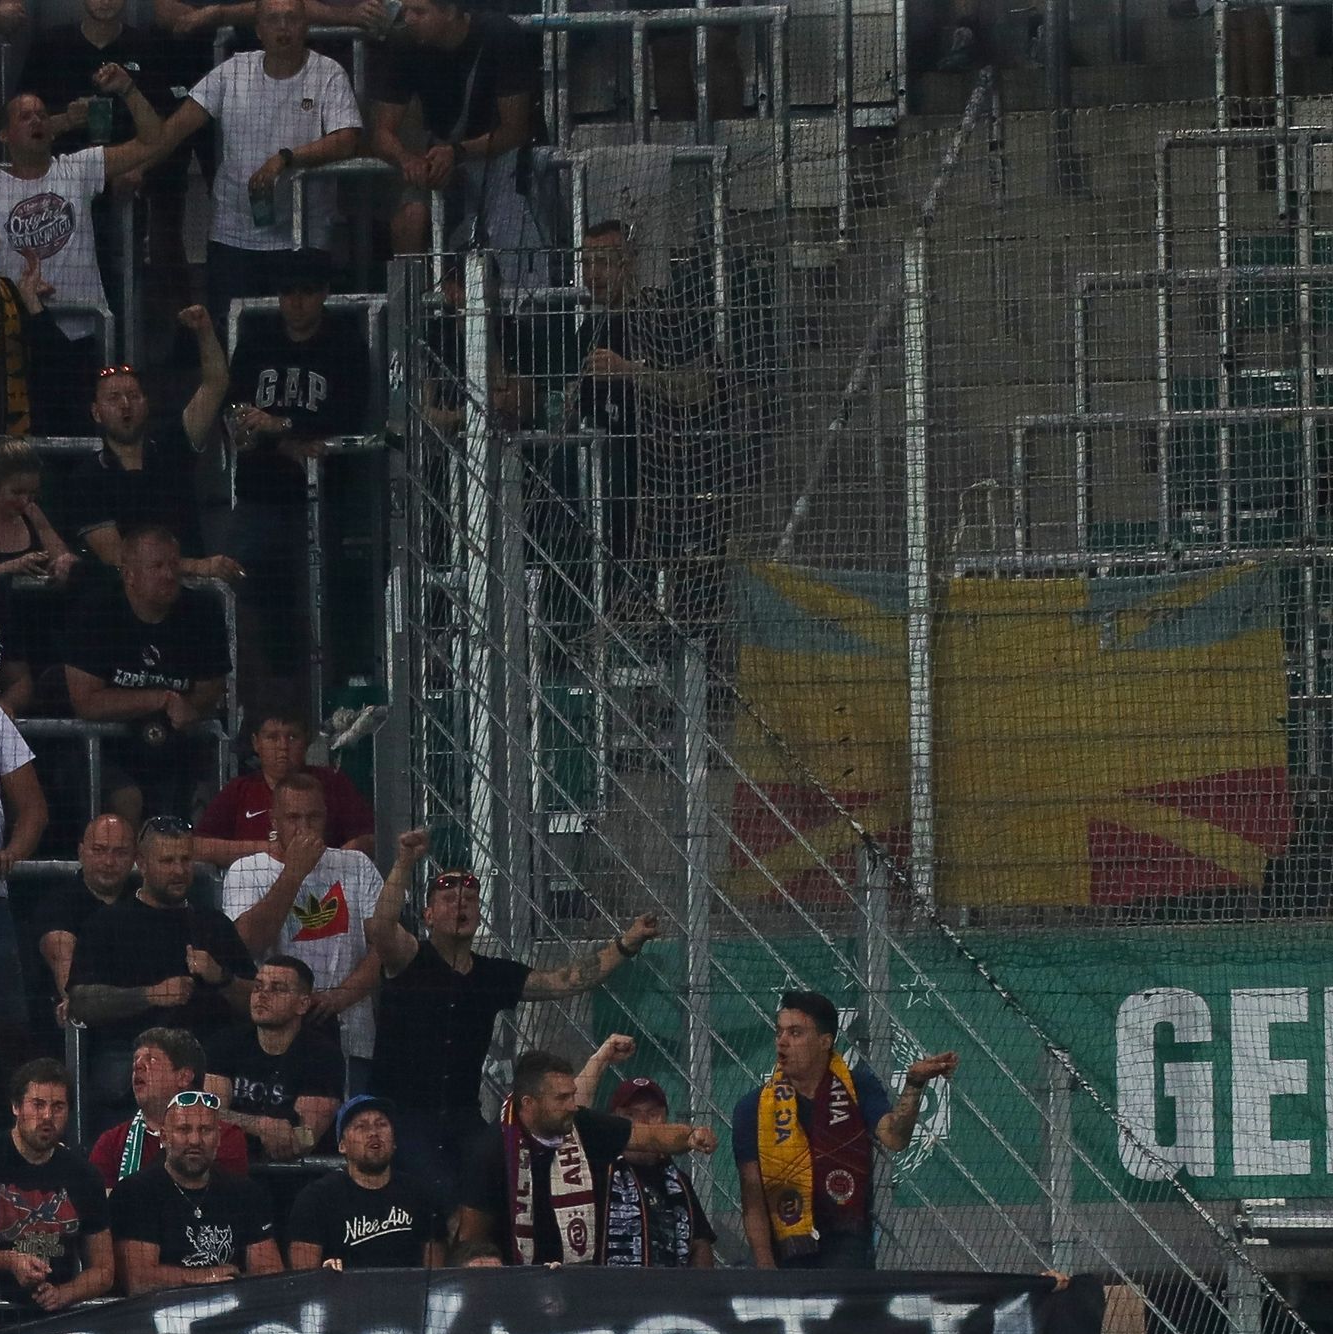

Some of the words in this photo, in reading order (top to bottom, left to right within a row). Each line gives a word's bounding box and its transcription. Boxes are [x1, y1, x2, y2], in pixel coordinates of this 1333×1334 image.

[1115, 986, 1333, 1184] GE
[344, 1215, 384, 1244] Nike
[381, 1206, 414, 1231] Air
